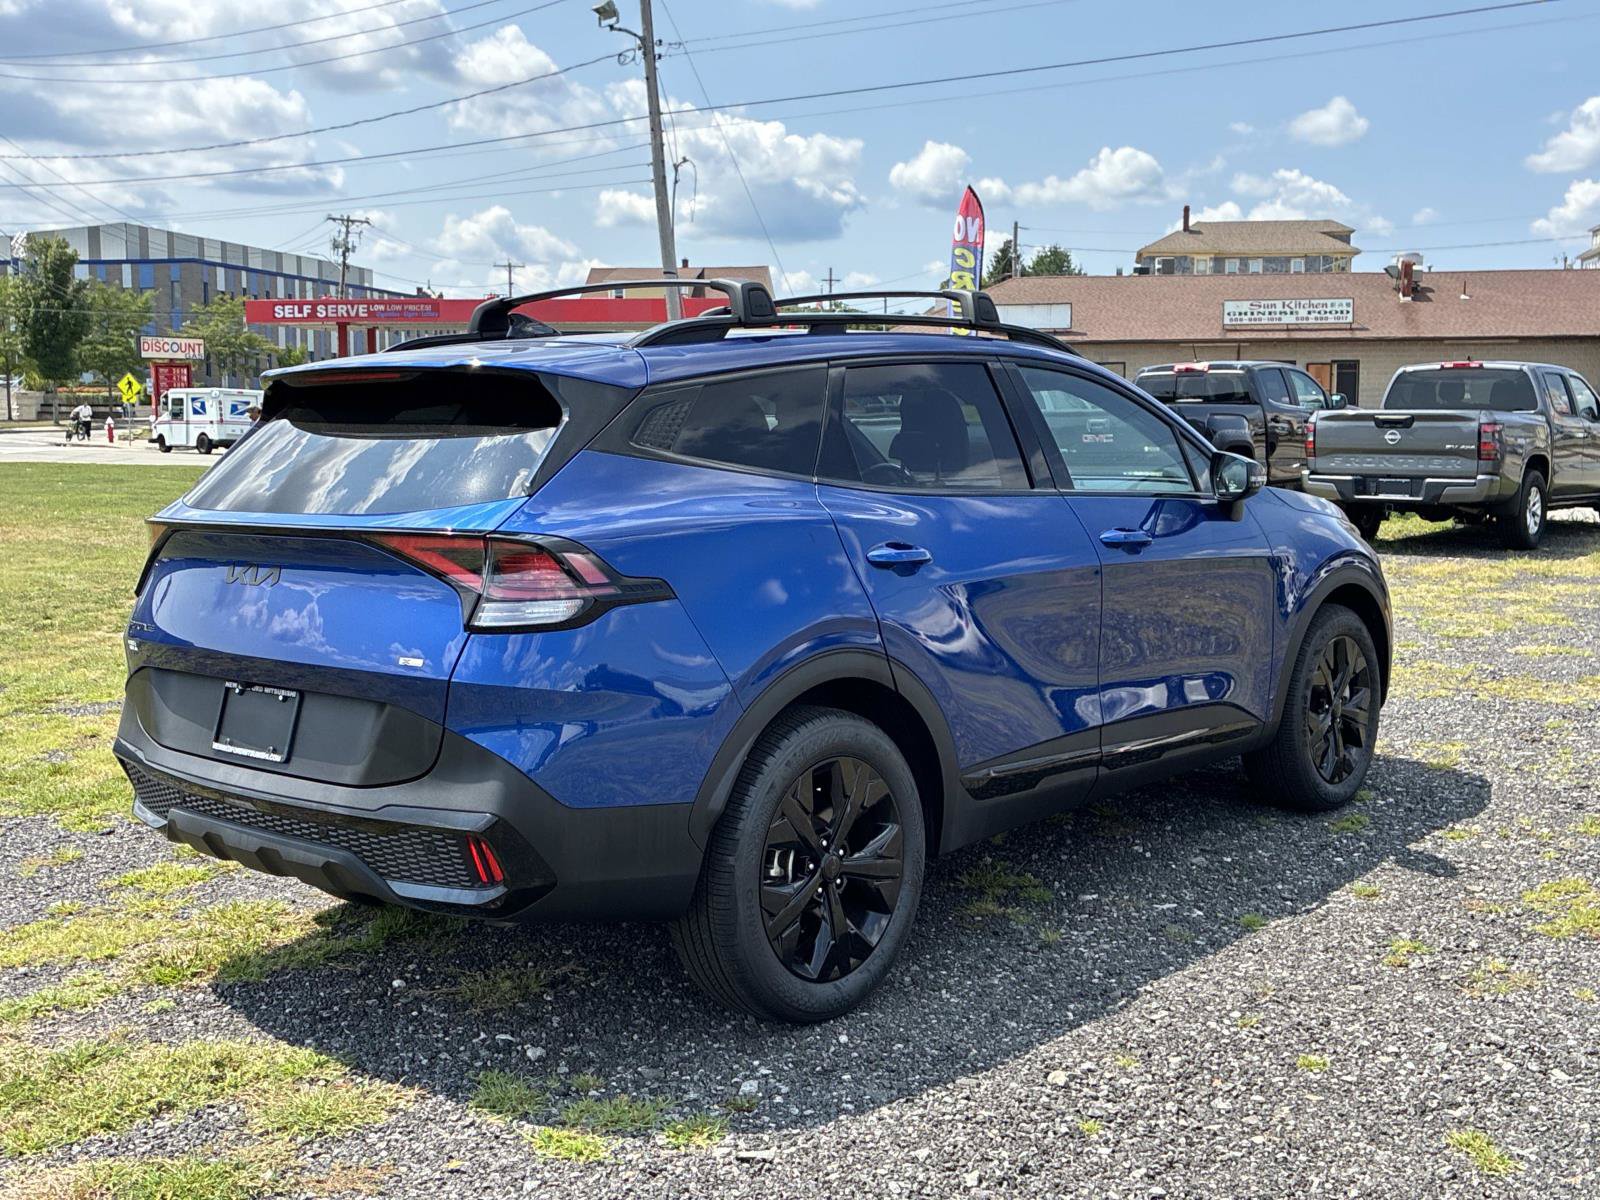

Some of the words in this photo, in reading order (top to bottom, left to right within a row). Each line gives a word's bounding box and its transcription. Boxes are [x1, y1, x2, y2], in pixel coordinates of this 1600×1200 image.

[369, 304, 385, 312] LOW
[387, 304, 402, 312] LOW
[1248, 301, 1277, 310] Sun
[1282, 300, 1328, 310] Kitchen
[274, 305, 311, 319] SELF
[316, 304, 368, 318] SERVE
[142, 341, 203, 353] DISCOUNT
[1329, 455, 1463, 468] FRONTIER
